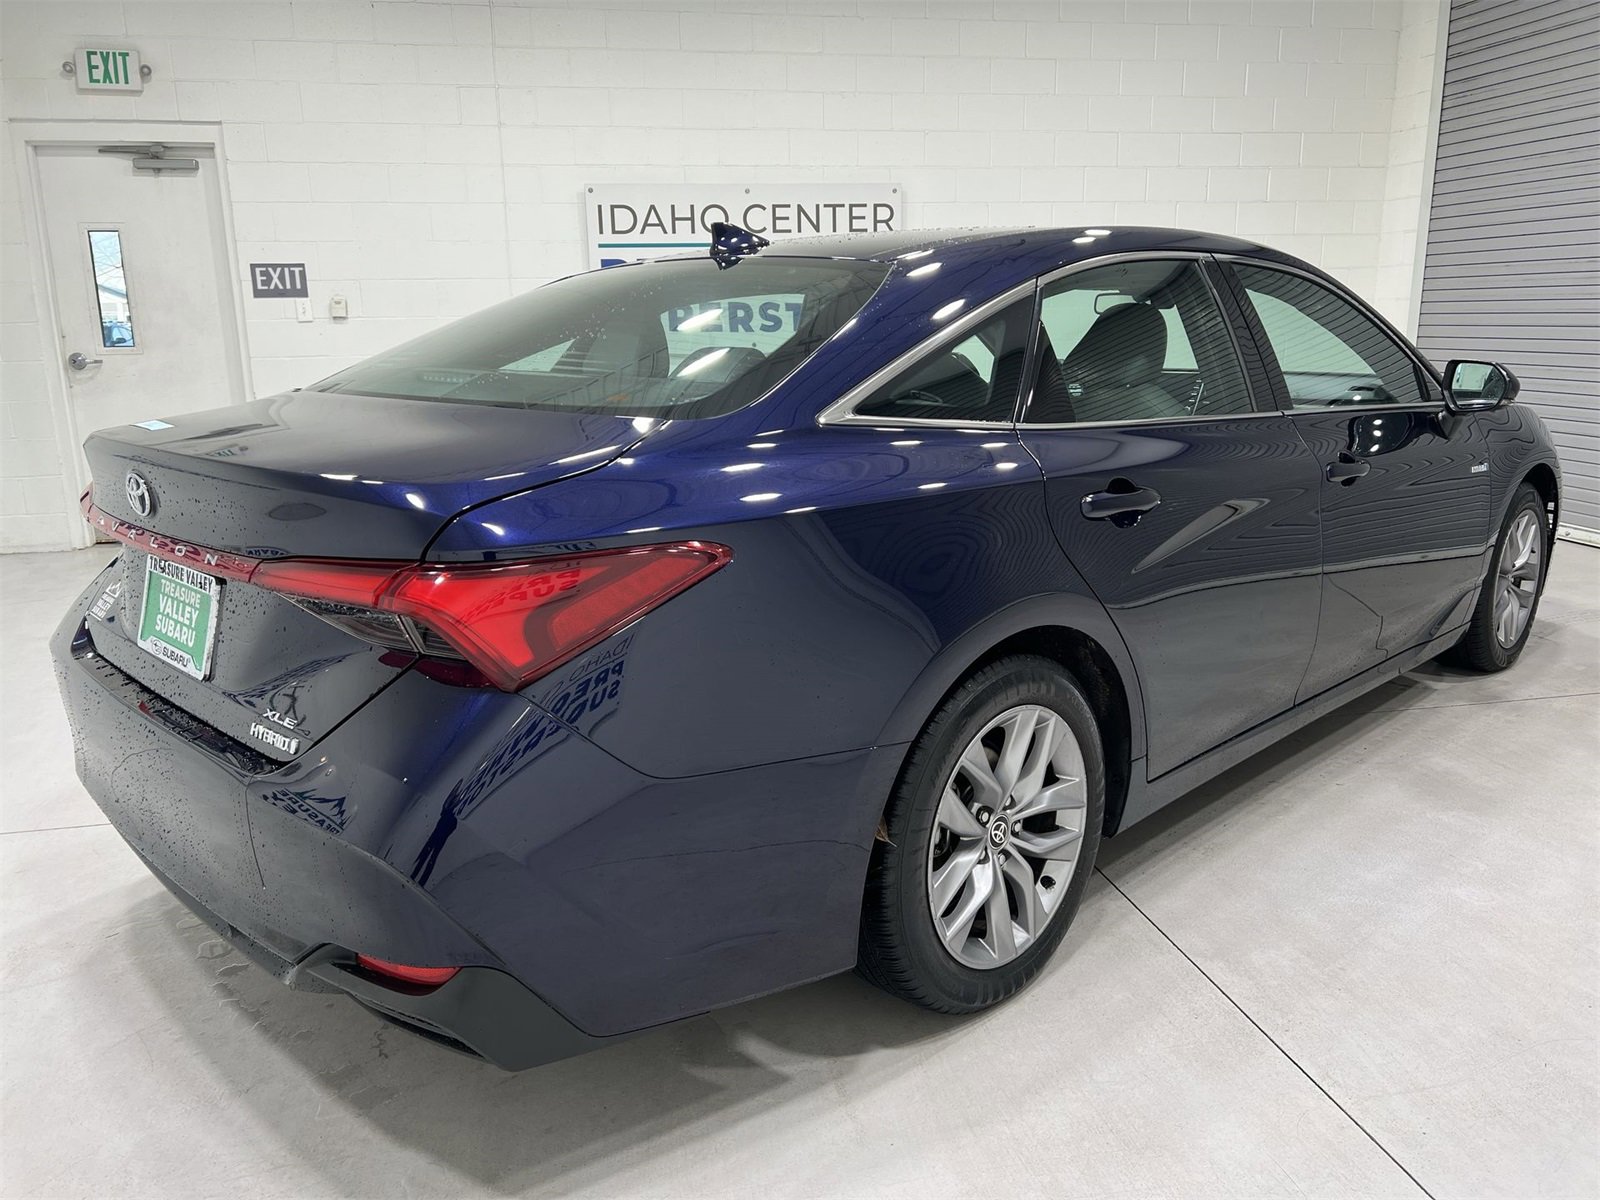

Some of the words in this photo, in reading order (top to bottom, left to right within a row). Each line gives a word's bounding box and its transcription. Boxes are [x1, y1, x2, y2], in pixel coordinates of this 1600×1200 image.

[86, 51, 129, 84] EXIT
[597, 204, 730, 235] IDAHO
[743, 203, 895, 234] CENTER
[255, 267, 303, 290] EXIT
[97, 515, 219, 566] AVALON
[150, 556, 185, 582] TREASURE
[186, 568, 213, 594] VALLEY
[161, 578, 201, 609] TREASURE
[159, 593, 199, 628] VALLEY
[155, 613, 196, 648] SUBARU
[162, 646, 189, 668] SUBARU
[262, 708, 298, 729] XLE
[250, 722, 290, 751] HYBRID
